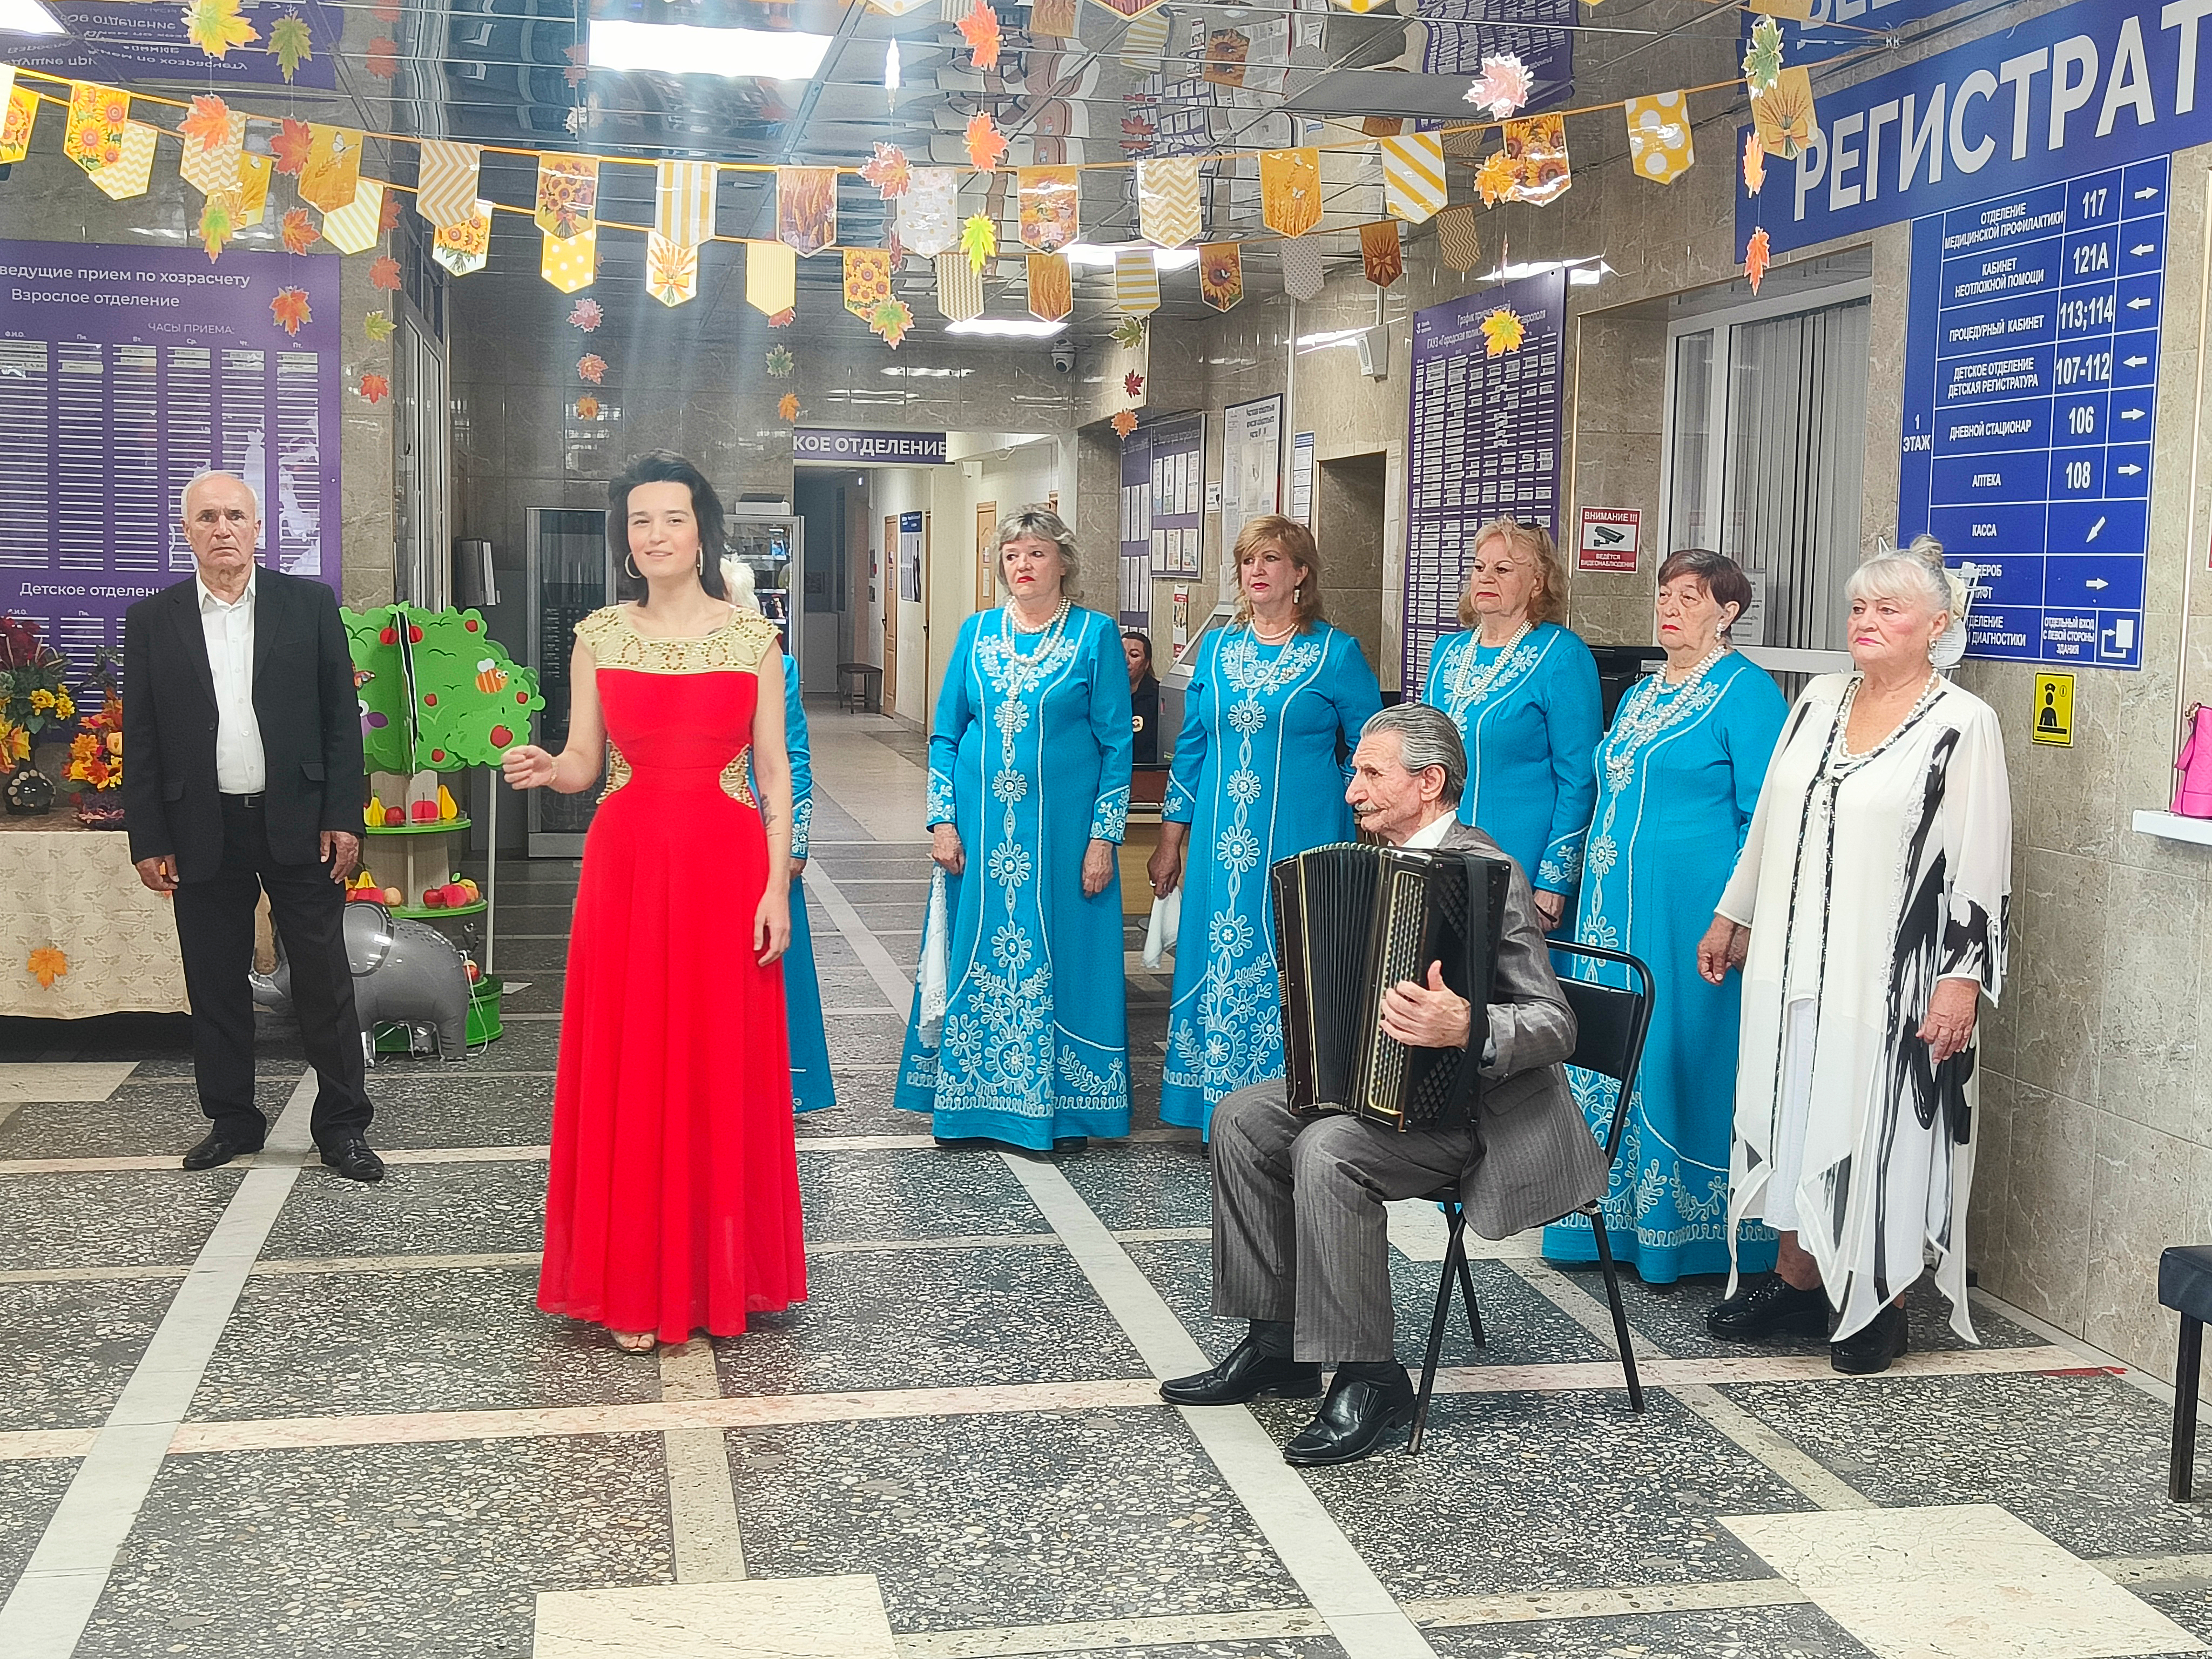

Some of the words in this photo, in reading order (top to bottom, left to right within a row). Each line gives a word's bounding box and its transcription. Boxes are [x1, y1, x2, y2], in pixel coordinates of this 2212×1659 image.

[2082, 188, 2107, 219] 117
[1980, 203, 2026, 225] ОТДЕЛЕНИЕ
[1945, 224, 1999, 249] МЕДИЦИНСКОЙ
[2000, 211, 2064, 237] ПРОФИЛАКТИКИ
[0, 265, 73, 280] ведущие
[78, 269, 131, 282] прием
[136, 272, 156, 282] по
[160, 273, 250, 288] хозрасчету
[1982, 257, 2017, 276] КАБИНЕТ
[1955, 274, 2006, 298] НЕОТЛОЖНОЙ
[2007, 269, 2044, 288] ПОМОЩИ
[12, 288, 90, 304] Взрослое
[94, 293, 180, 308] отделение
[2060, 295, 2113, 331] 113;114
[149, 323, 181, 333] ЧАСЫ
[184, 324, 235, 335] ПРИЕМА:
[1950, 319, 2004, 342] ПРОЦЕДУРНЫЙ
[2007, 315, 2045, 333] КАБИНЕТ
[1953, 363, 1987, 382] ДЕТСКОЕ
[1988, 357, 2034, 376] ОТДЕЛЕНИЕ
[2056, 353, 2110, 385] 107-112
[1947, 381, 1981, 399] ДЕТСКАЯ
[1982, 374, 2039, 393] РЕГИСТРАТУРА
[1914, 414, 1920, 430] 1
[1949, 421, 1985, 441] ДНЕВНОЙ
[1985, 420, 2032, 437] СТАЦИОНАР
[2069, 406, 2094, 435] 106
[793, 436, 831, 451] КОЕ
[835, 437, 946, 456] ОТДЕЛЕНИЕ
[1903, 434, 1931, 452] ЭТАЖ
[1972, 473, 2001, 488] АПТЕКА
[2066, 461, 2091, 489] 108
[1584, 511, 1629, 522] ВНИМАНИЕ
[1972, 523, 1997, 537] КАССА
[1977, 564, 2002, 579] ДЕРОБ
[19, 582, 85, 596] Детское
[90, 586, 159, 598] отделен
[1966, 615, 2004, 629] ТДЕЛЕНИЕ
[1971, 631, 2026, 646] ДИАГНОСТИКИ
[2043, 630, 2047, 640] С
[2047, 629, 2066, 640] ЛЕВОЙ
[2067, 631, 2095, 643] СТОРОНЫ
